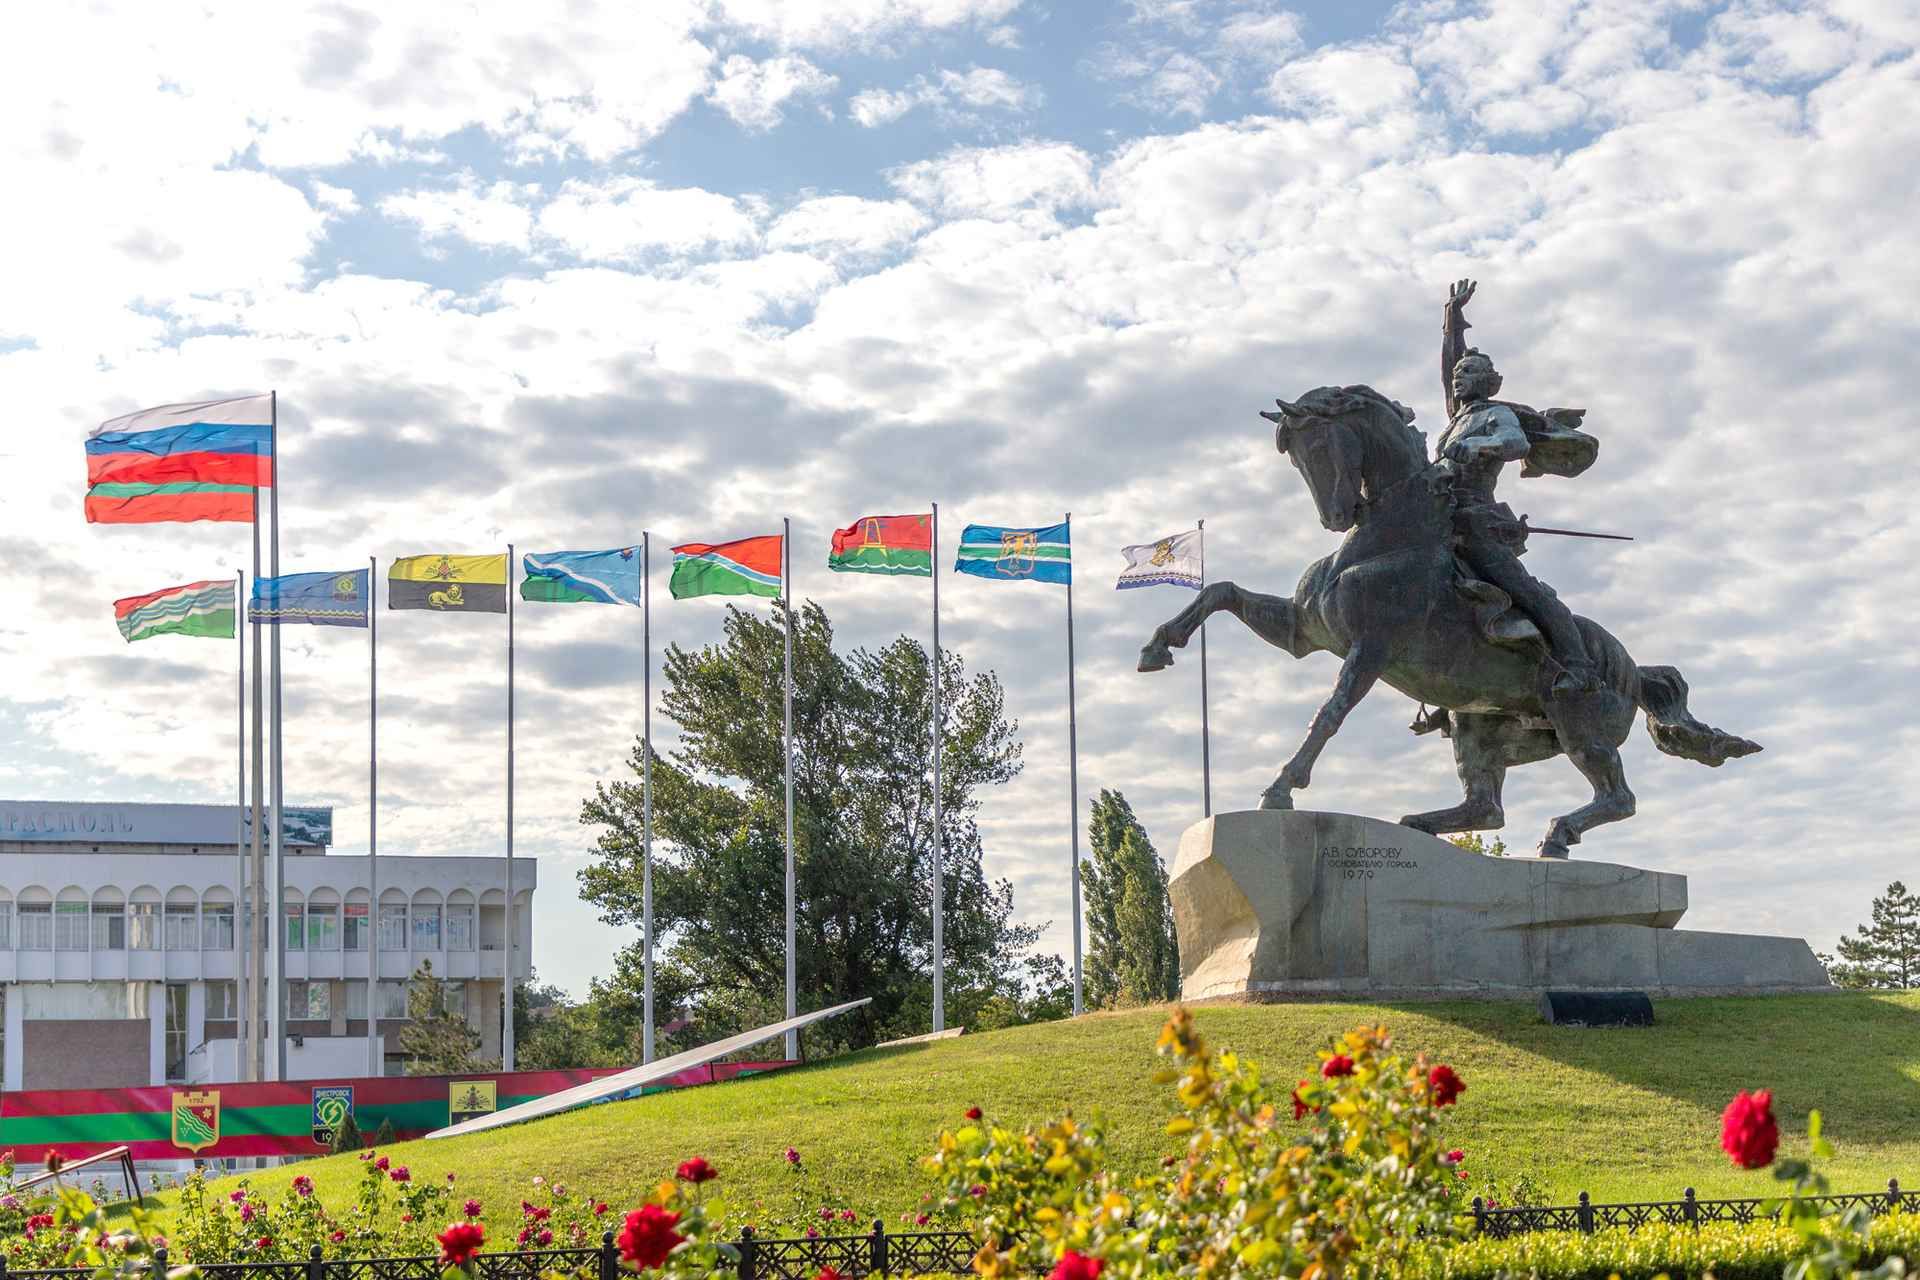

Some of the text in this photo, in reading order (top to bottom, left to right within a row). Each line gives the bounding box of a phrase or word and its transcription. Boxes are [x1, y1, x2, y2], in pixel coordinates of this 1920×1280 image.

[0, 811, 134, 833] РАСПОЛЬ
[1345, 847, 1401, 859] СУВОРОВУ
[1387, 861, 1418, 869] ГОРОДА
[1343, 869, 1375, 880] 1979
